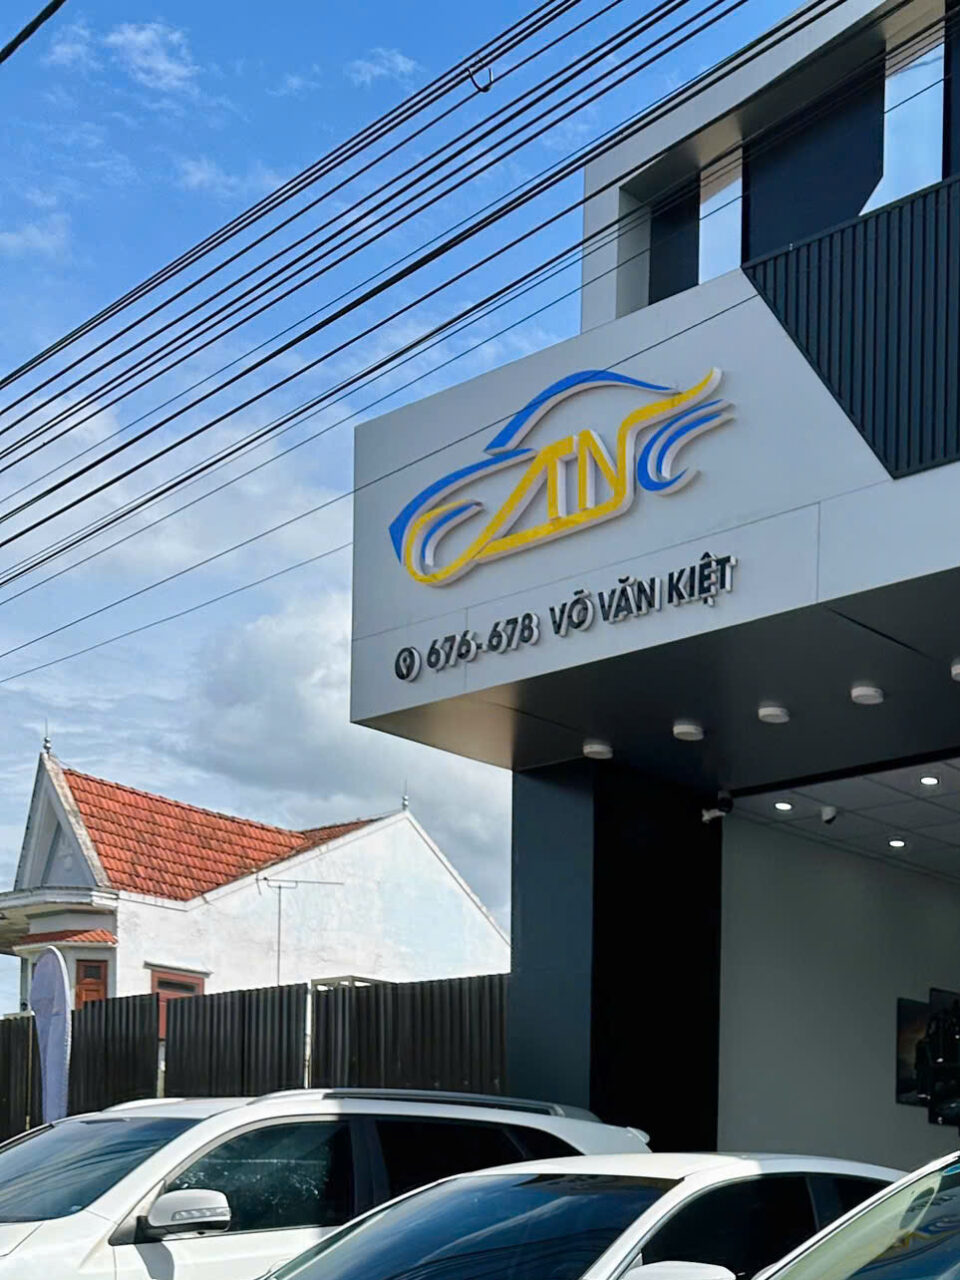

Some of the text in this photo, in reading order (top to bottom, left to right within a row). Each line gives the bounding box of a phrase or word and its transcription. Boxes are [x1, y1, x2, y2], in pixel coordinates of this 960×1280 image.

[426, 551, 738, 673] 676-678 VÕ VĂN KIỆT
